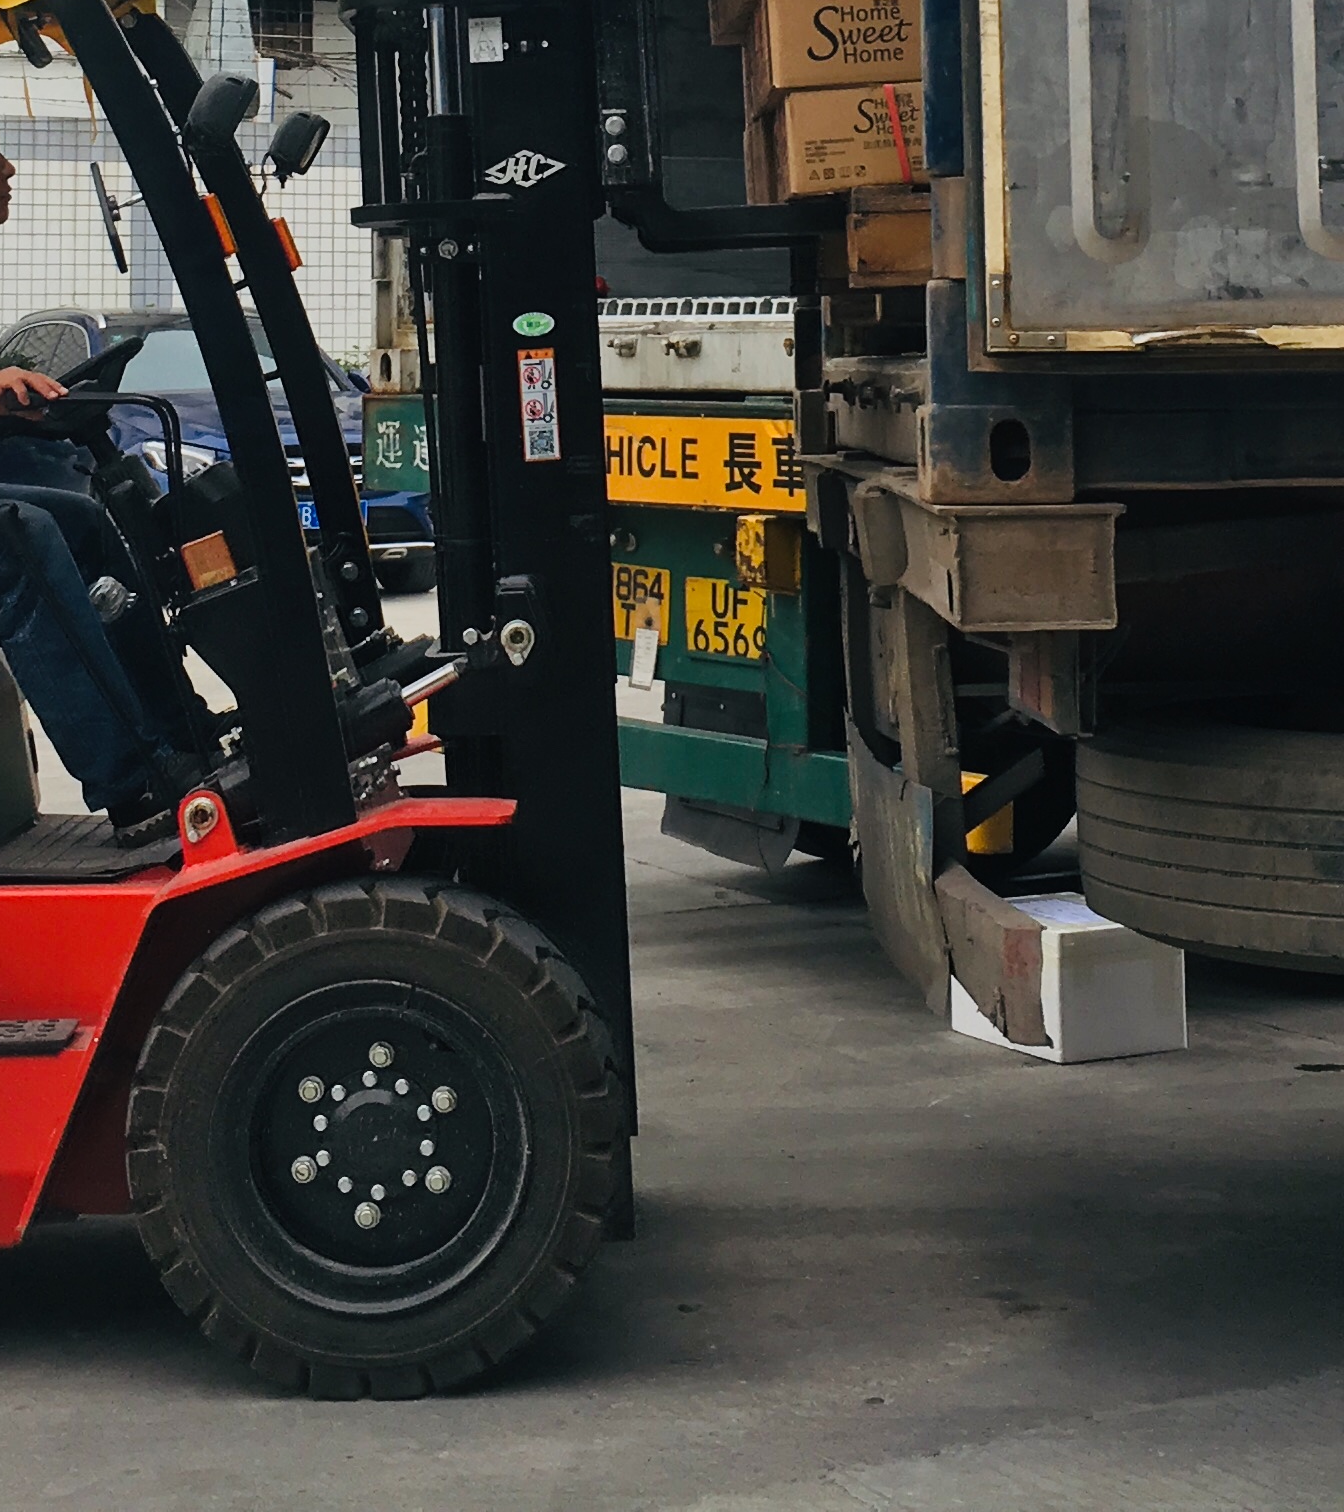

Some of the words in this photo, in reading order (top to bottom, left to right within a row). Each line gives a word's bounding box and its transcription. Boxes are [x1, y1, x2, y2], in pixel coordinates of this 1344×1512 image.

[840, 6, 901, 22] Home
[807, 5, 913, 61] Sweet
[843, 46, 904, 64] Home
[853, 98, 920, 133] Swet
[606, 435, 699, 480] HICLE
[711, 582, 751, 620] UF
[621, 602, 636, 637] T
